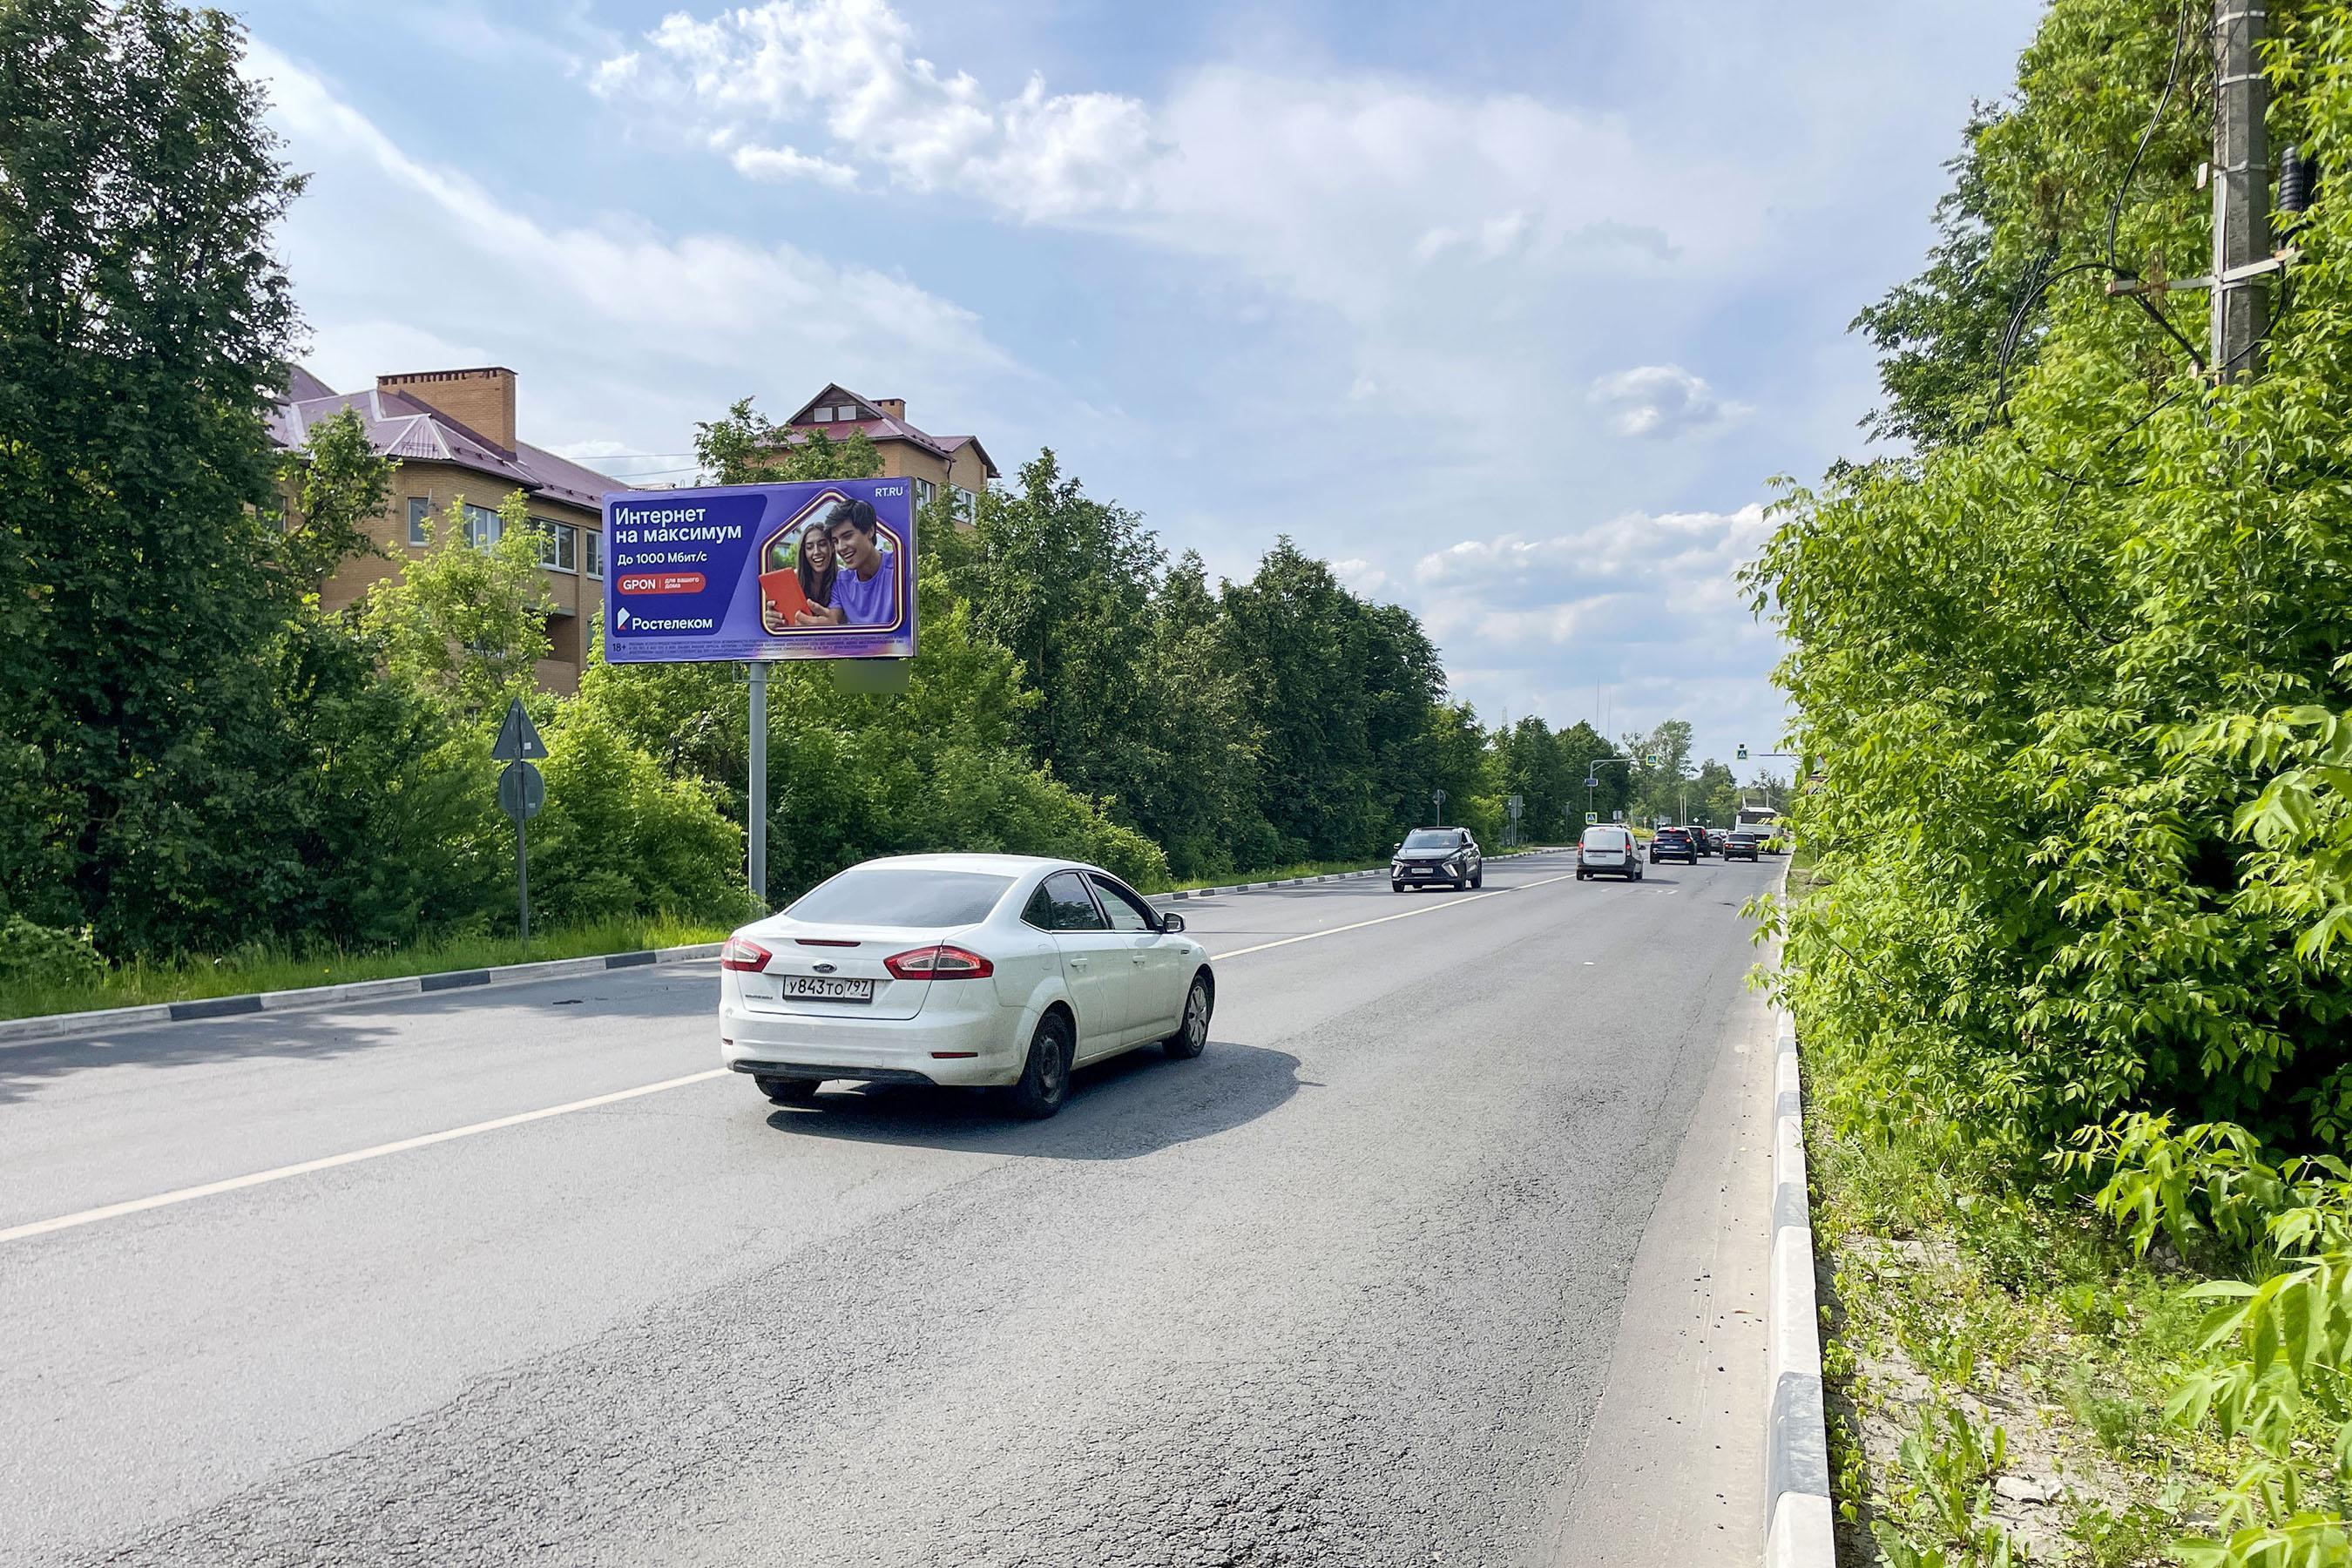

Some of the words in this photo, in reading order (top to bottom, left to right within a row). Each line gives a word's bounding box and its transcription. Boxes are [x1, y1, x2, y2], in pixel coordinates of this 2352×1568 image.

[875, 486, 903, 497] RT.RU
[615, 507, 706, 528] Интернет
[615, 530, 638, 544] на
[644, 524, 741, 544] максимум
[617, 553, 634, 566] До
[636, 552, 665, 564] 1000
[667, 551, 707, 564] Мбит/с
[623, 578, 656, 591] GPON
[632, 617, 713, 631] Ростелеком
[612, 643, 626, 652] 18+
